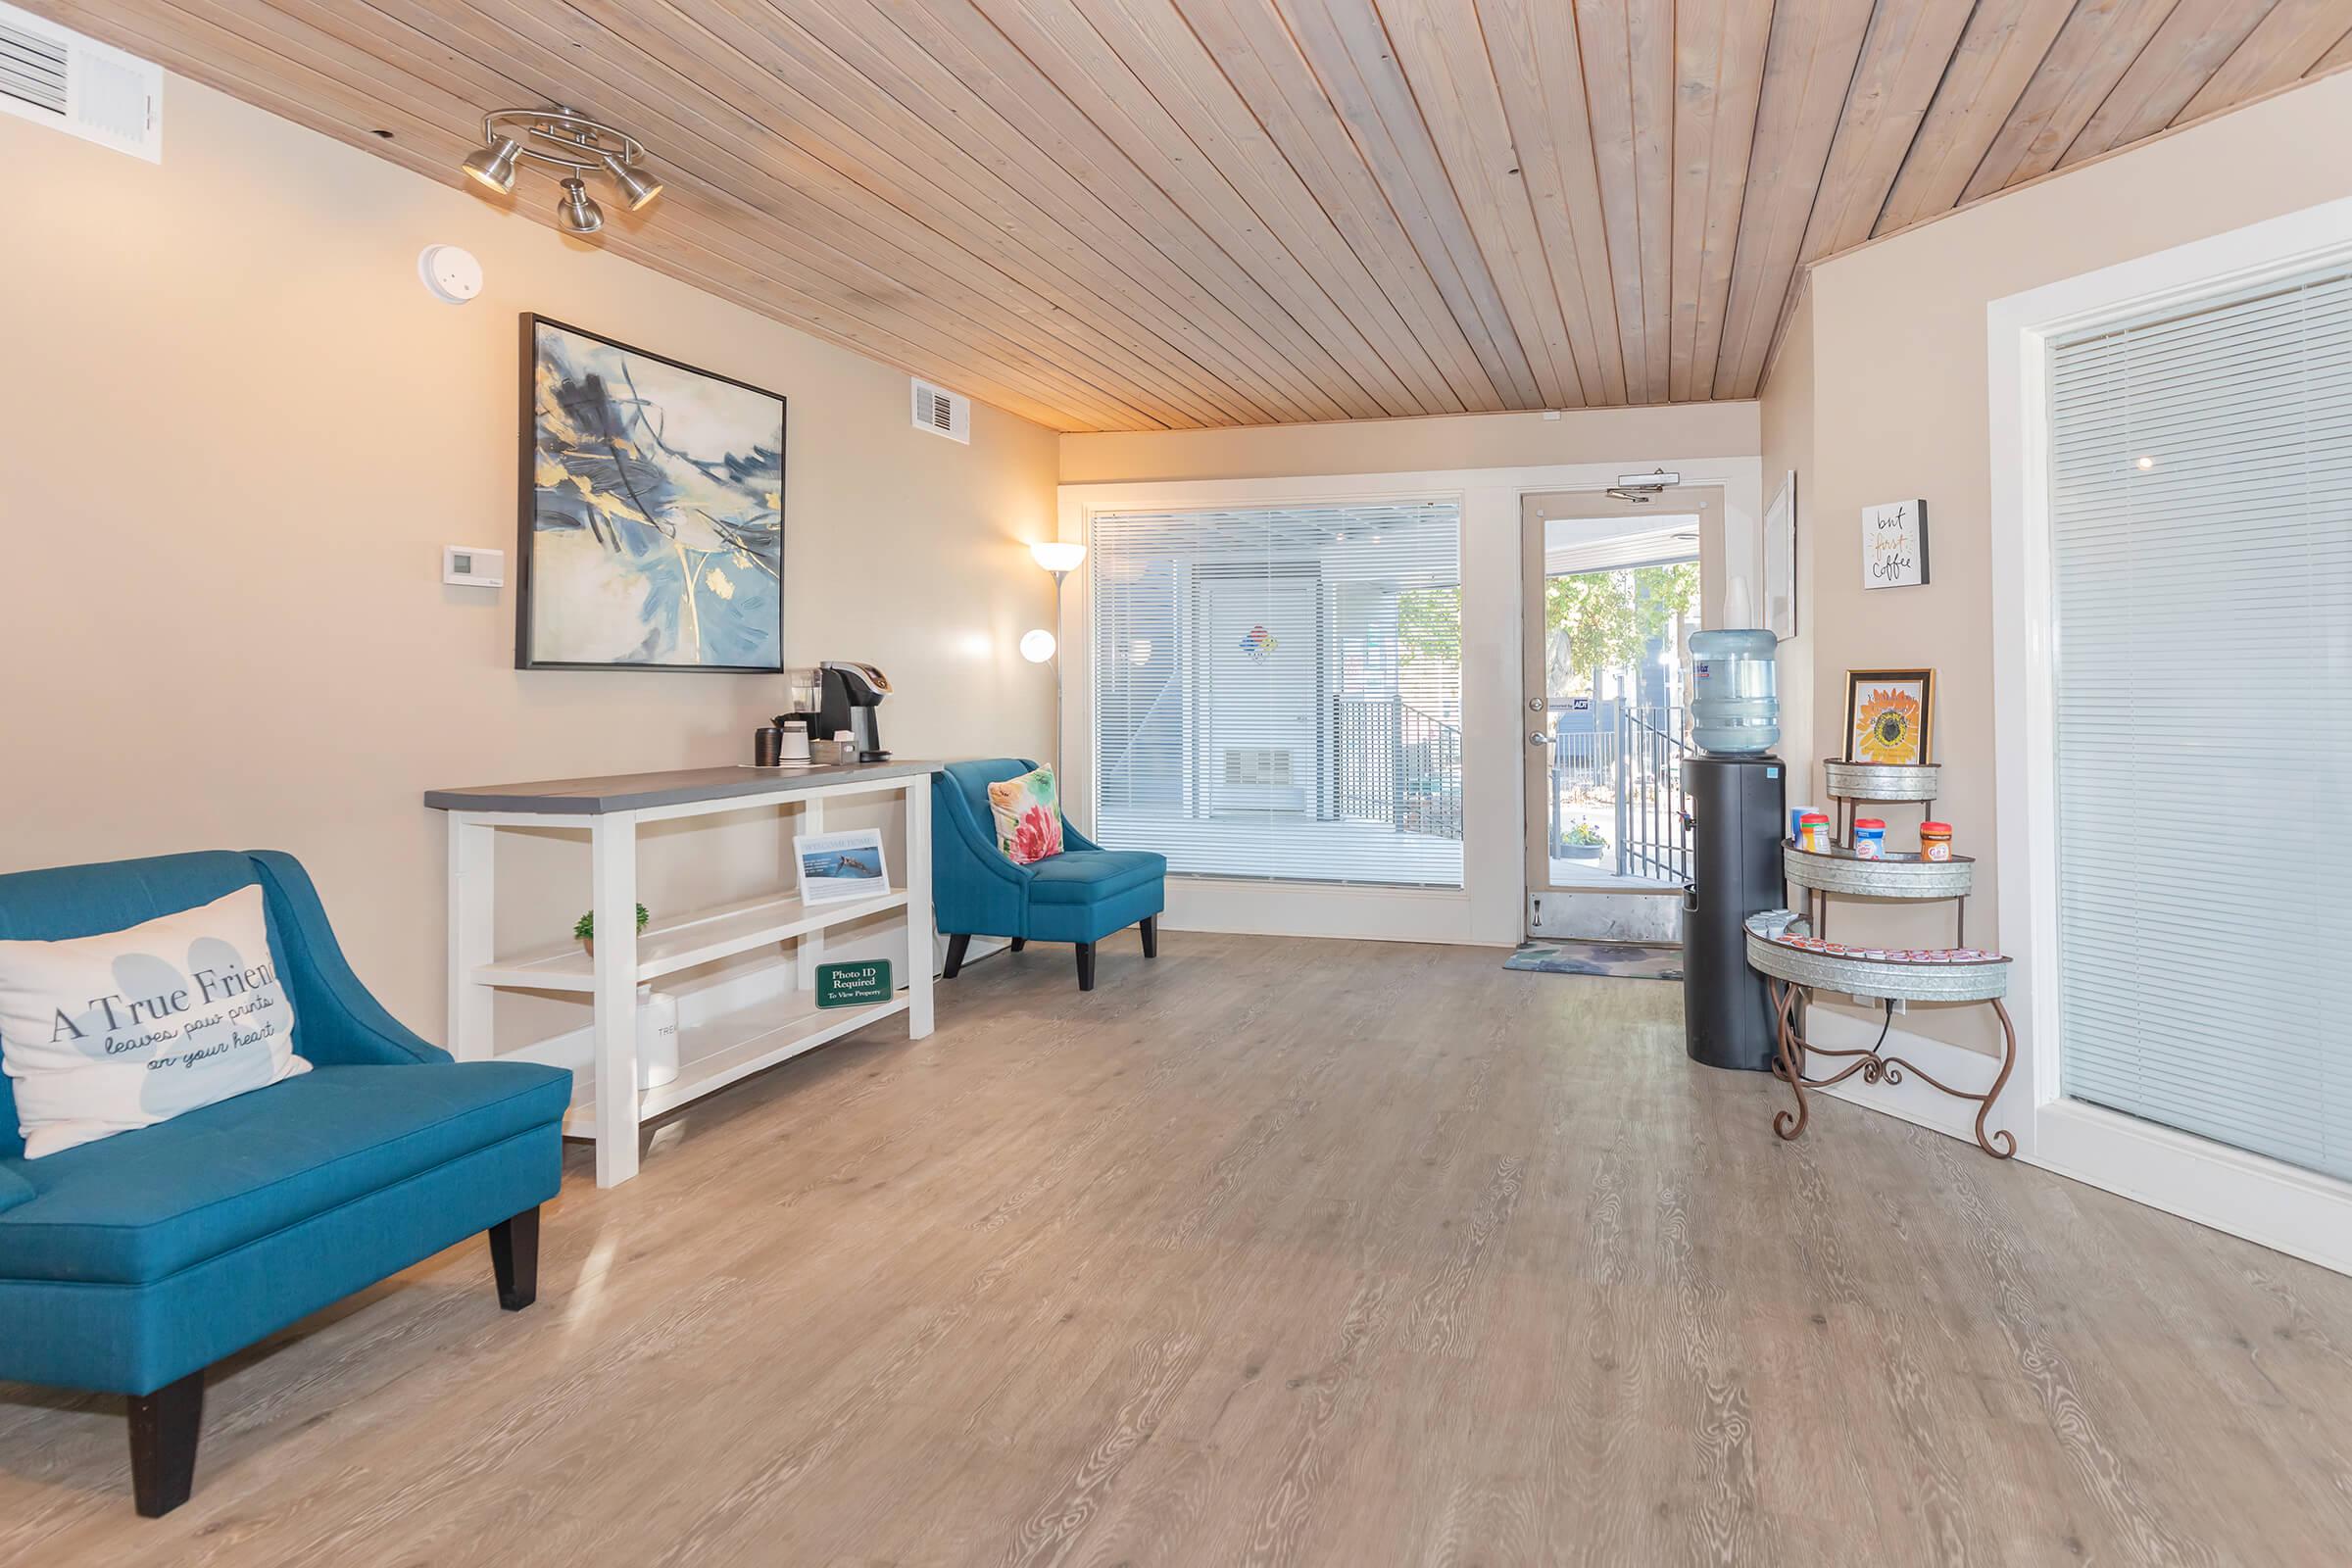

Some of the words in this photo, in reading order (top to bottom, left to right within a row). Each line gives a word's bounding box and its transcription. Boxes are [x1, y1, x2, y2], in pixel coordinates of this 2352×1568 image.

[1875, 533, 1907, 562] first
[1574, 700, 1588, 710] ADT
[832, 970, 860, 980] Photo
[862, 967, 876, 977] ID
[833, 977, 875, 989] Required
[50, 1007, 89, 1044] A
[88, 995, 191, 1032] True
[104, 1028, 178, 1055] leaves
[184, 1011, 222, 1040] paw
[229, 994, 274, 1022] prints
[658, 1025, 676, 1036] TRE
[147, 1057, 177, 1070] on
[182, 1042, 228, 1068] your
[232, 1023, 275, 1049] heart
